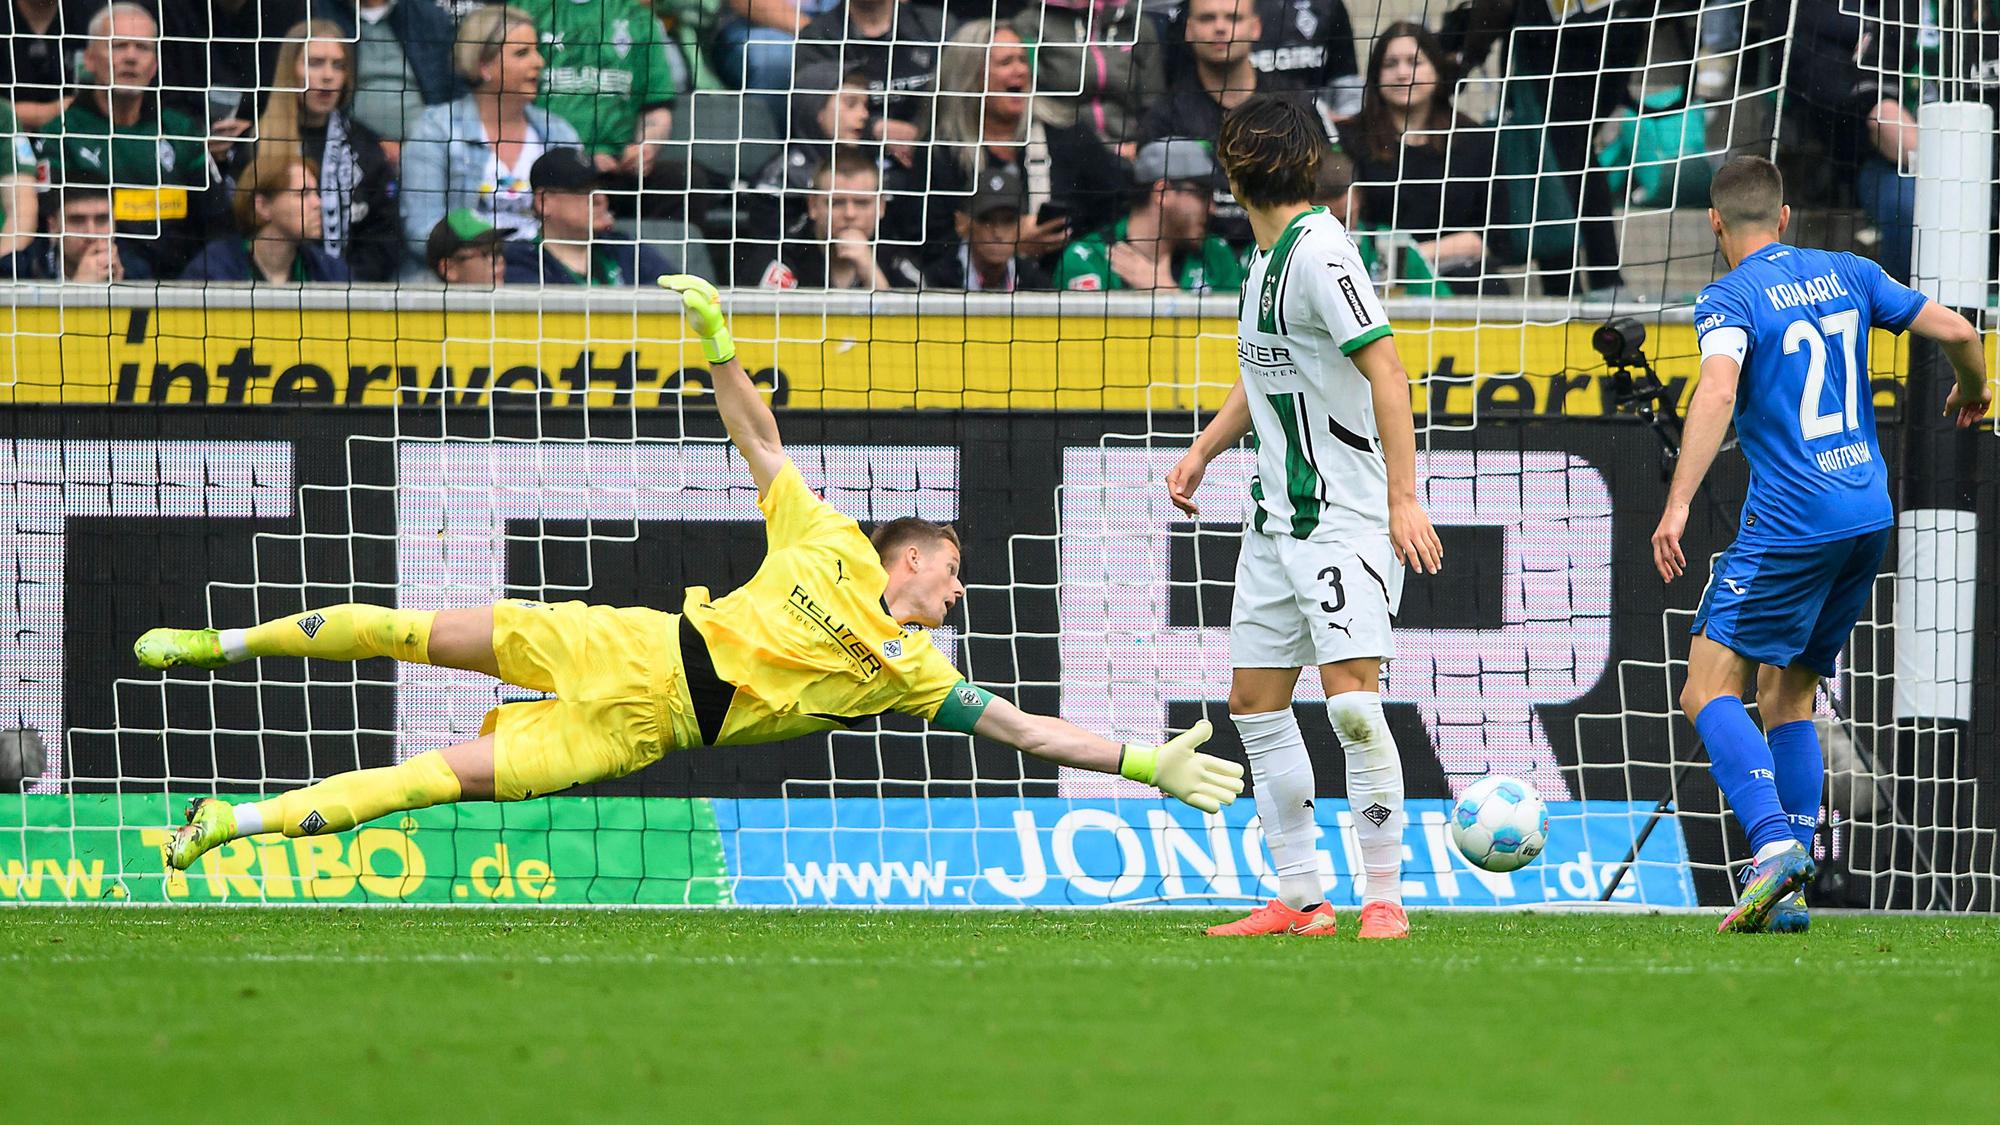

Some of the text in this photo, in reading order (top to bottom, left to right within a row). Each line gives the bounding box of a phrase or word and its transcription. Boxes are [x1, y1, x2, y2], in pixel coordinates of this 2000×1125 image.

[114, 309, 790, 405] interwetten
[1238, 336, 1292, 362] UTER
[1783, 309, 1859, 441] 27
[1317, 566, 1346, 613] 3
[789, 585, 883, 675] REUTER
[1787, 814, 1815, 828] TSG
